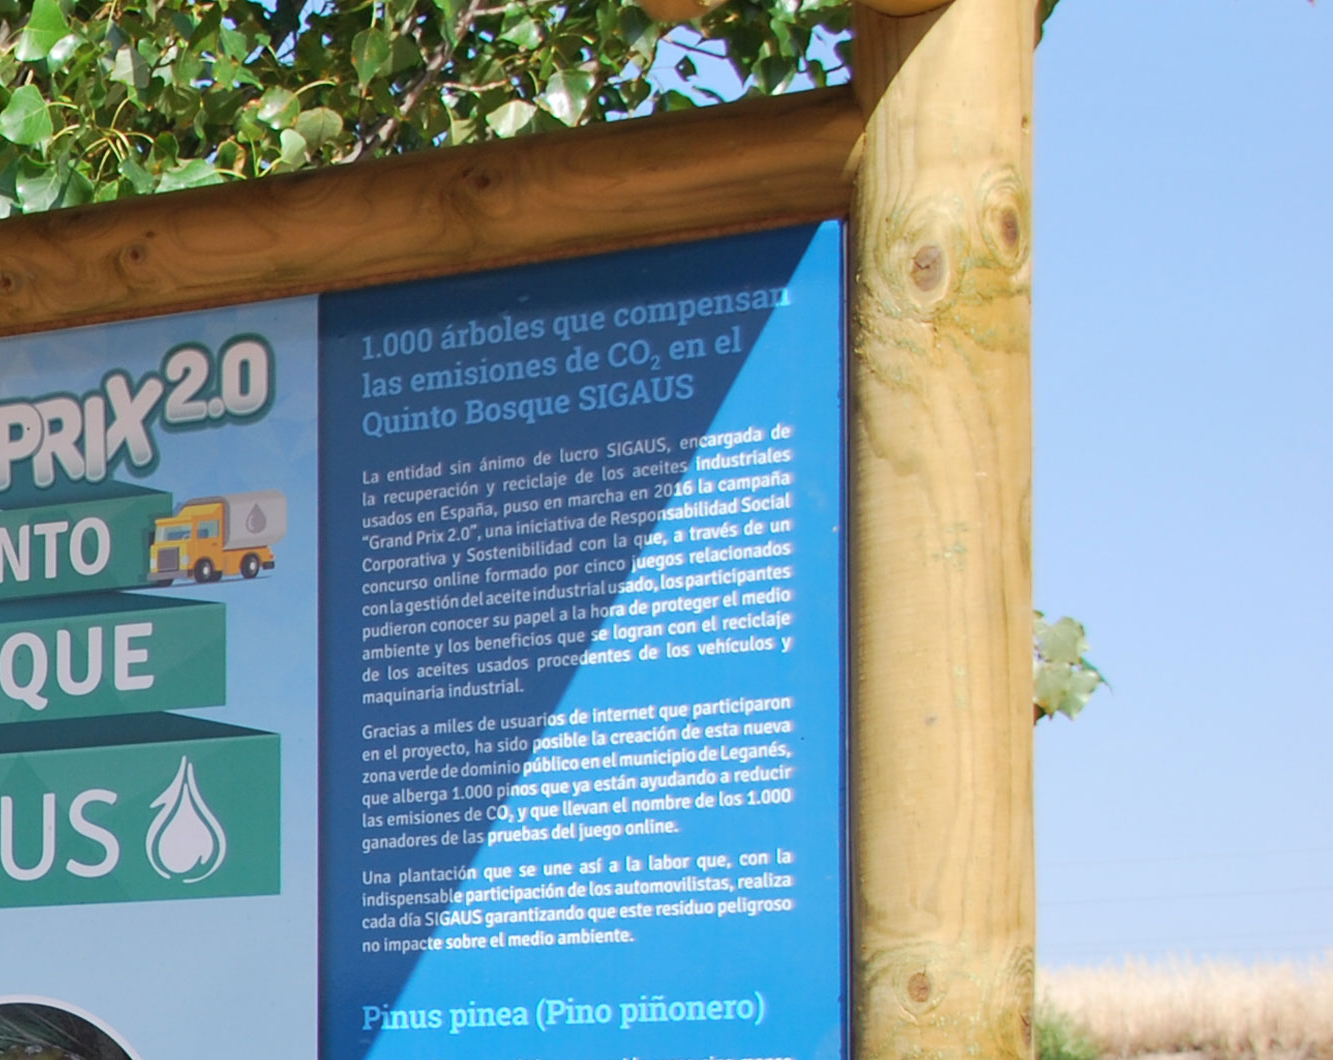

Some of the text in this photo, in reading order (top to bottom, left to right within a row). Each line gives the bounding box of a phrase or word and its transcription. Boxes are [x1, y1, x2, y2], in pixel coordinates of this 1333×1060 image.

[361, 287, 794, 360] 1.000 árboles que compensan
[163, 339, 272, 424] 2.0
[361, 372, 403, 398] las
[410, 357, 558, 391] emisiones
[565, 346, 600, 373] de
[669, 337, 707, 360] en
[714, 327, 741, 355] el
[362, 373, 695, 437] Quinto Bosque SIGAUS
[362, 423, 794, 485] La entidad sin ánimo de lucro SIGAUS, encargada de
[362, 448, 793, 507] la recuperación y reciclaje de los aceites industriales
[362, 470, 794, 528] usados en España, puso en marcha en 2016 la campaña
[361, 541, 794, 595] concurso online formado por cinco juegos relacionados
[361, 696, 794, 739] Gracias a miles de usuarios de internet que participaron
[362, 677, 525, 705] maquinaria industrial.
[361, 818, 682, 853] ganadores de las pruebas del juego online.
[361, 872, 796, 908] indispensable participación de los automovilistas, realiza
[362, 928, 636, 954] no impacte sobre el medio ambiente.
[362, 995, 768, 1034] Pinus pinea (Pino piñonero)
